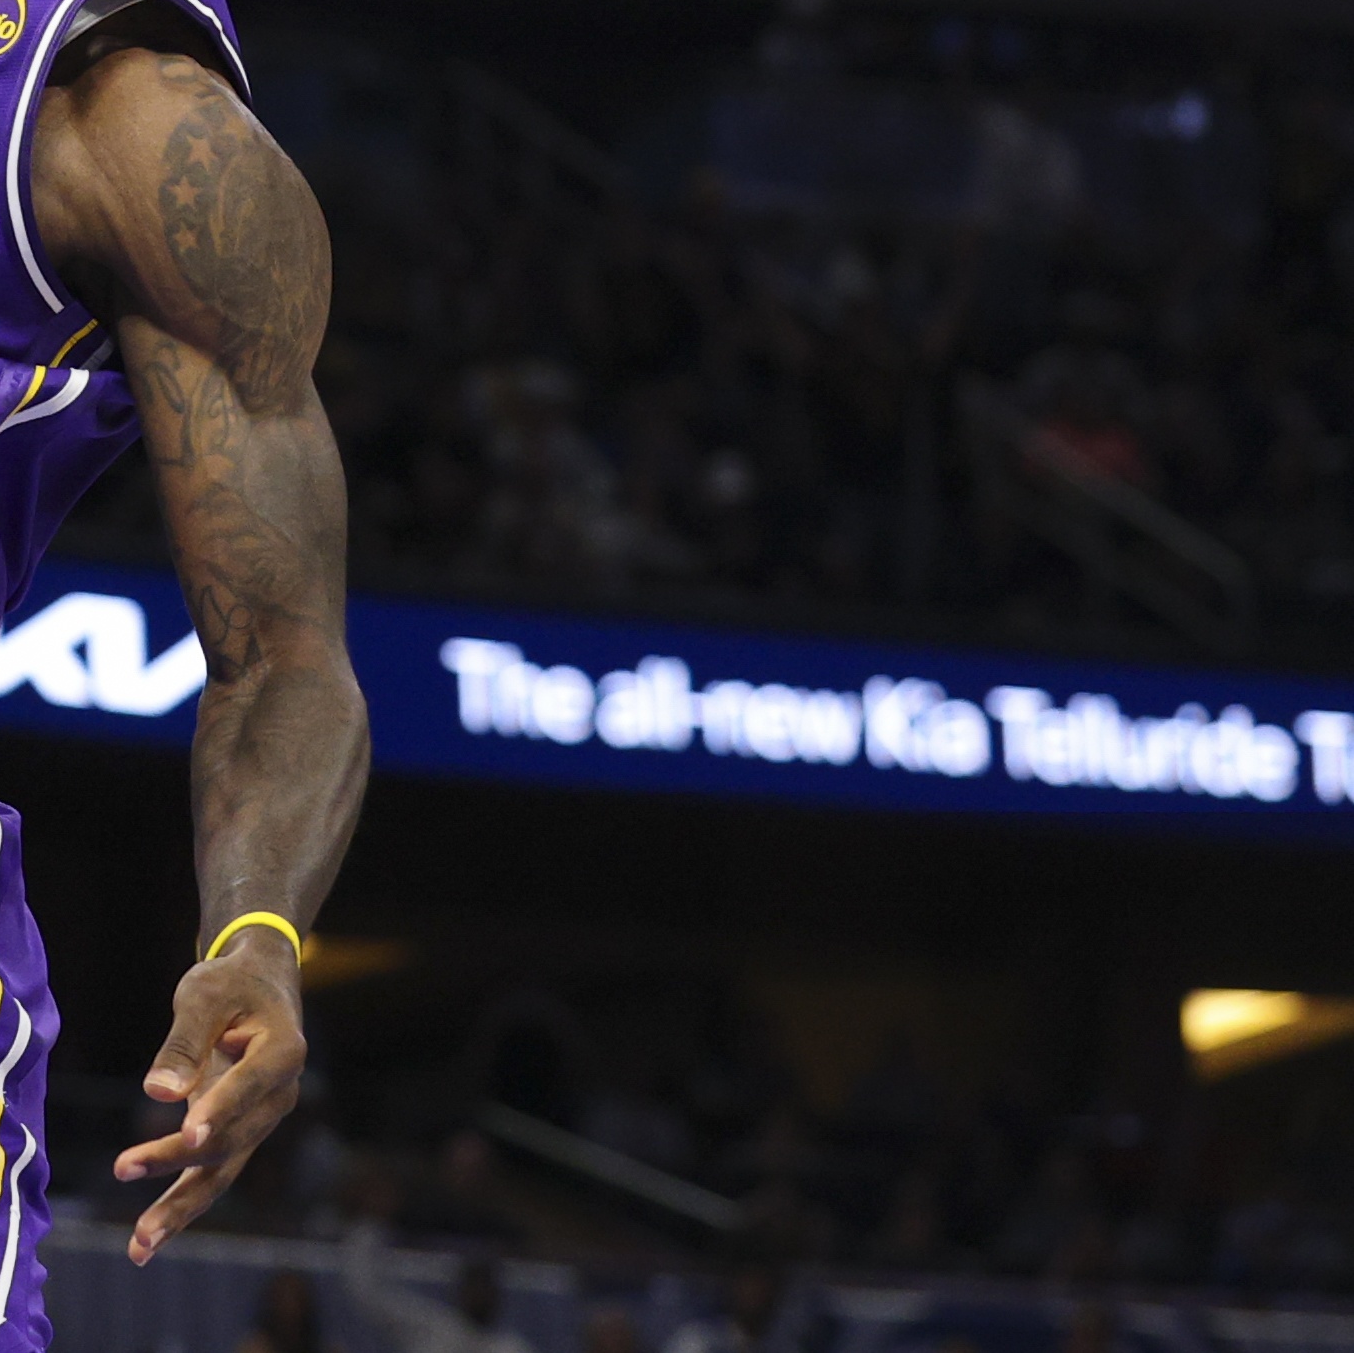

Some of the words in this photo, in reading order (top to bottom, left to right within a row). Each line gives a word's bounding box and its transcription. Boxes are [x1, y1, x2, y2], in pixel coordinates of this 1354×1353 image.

[440, 637, 596, 745] The
[596, 655, 863, 766] all-new
[863, 674, 992, 777] Kia
[986, 685, 1298, 803] Telluride
[1294, 709, 1354, 806] T
